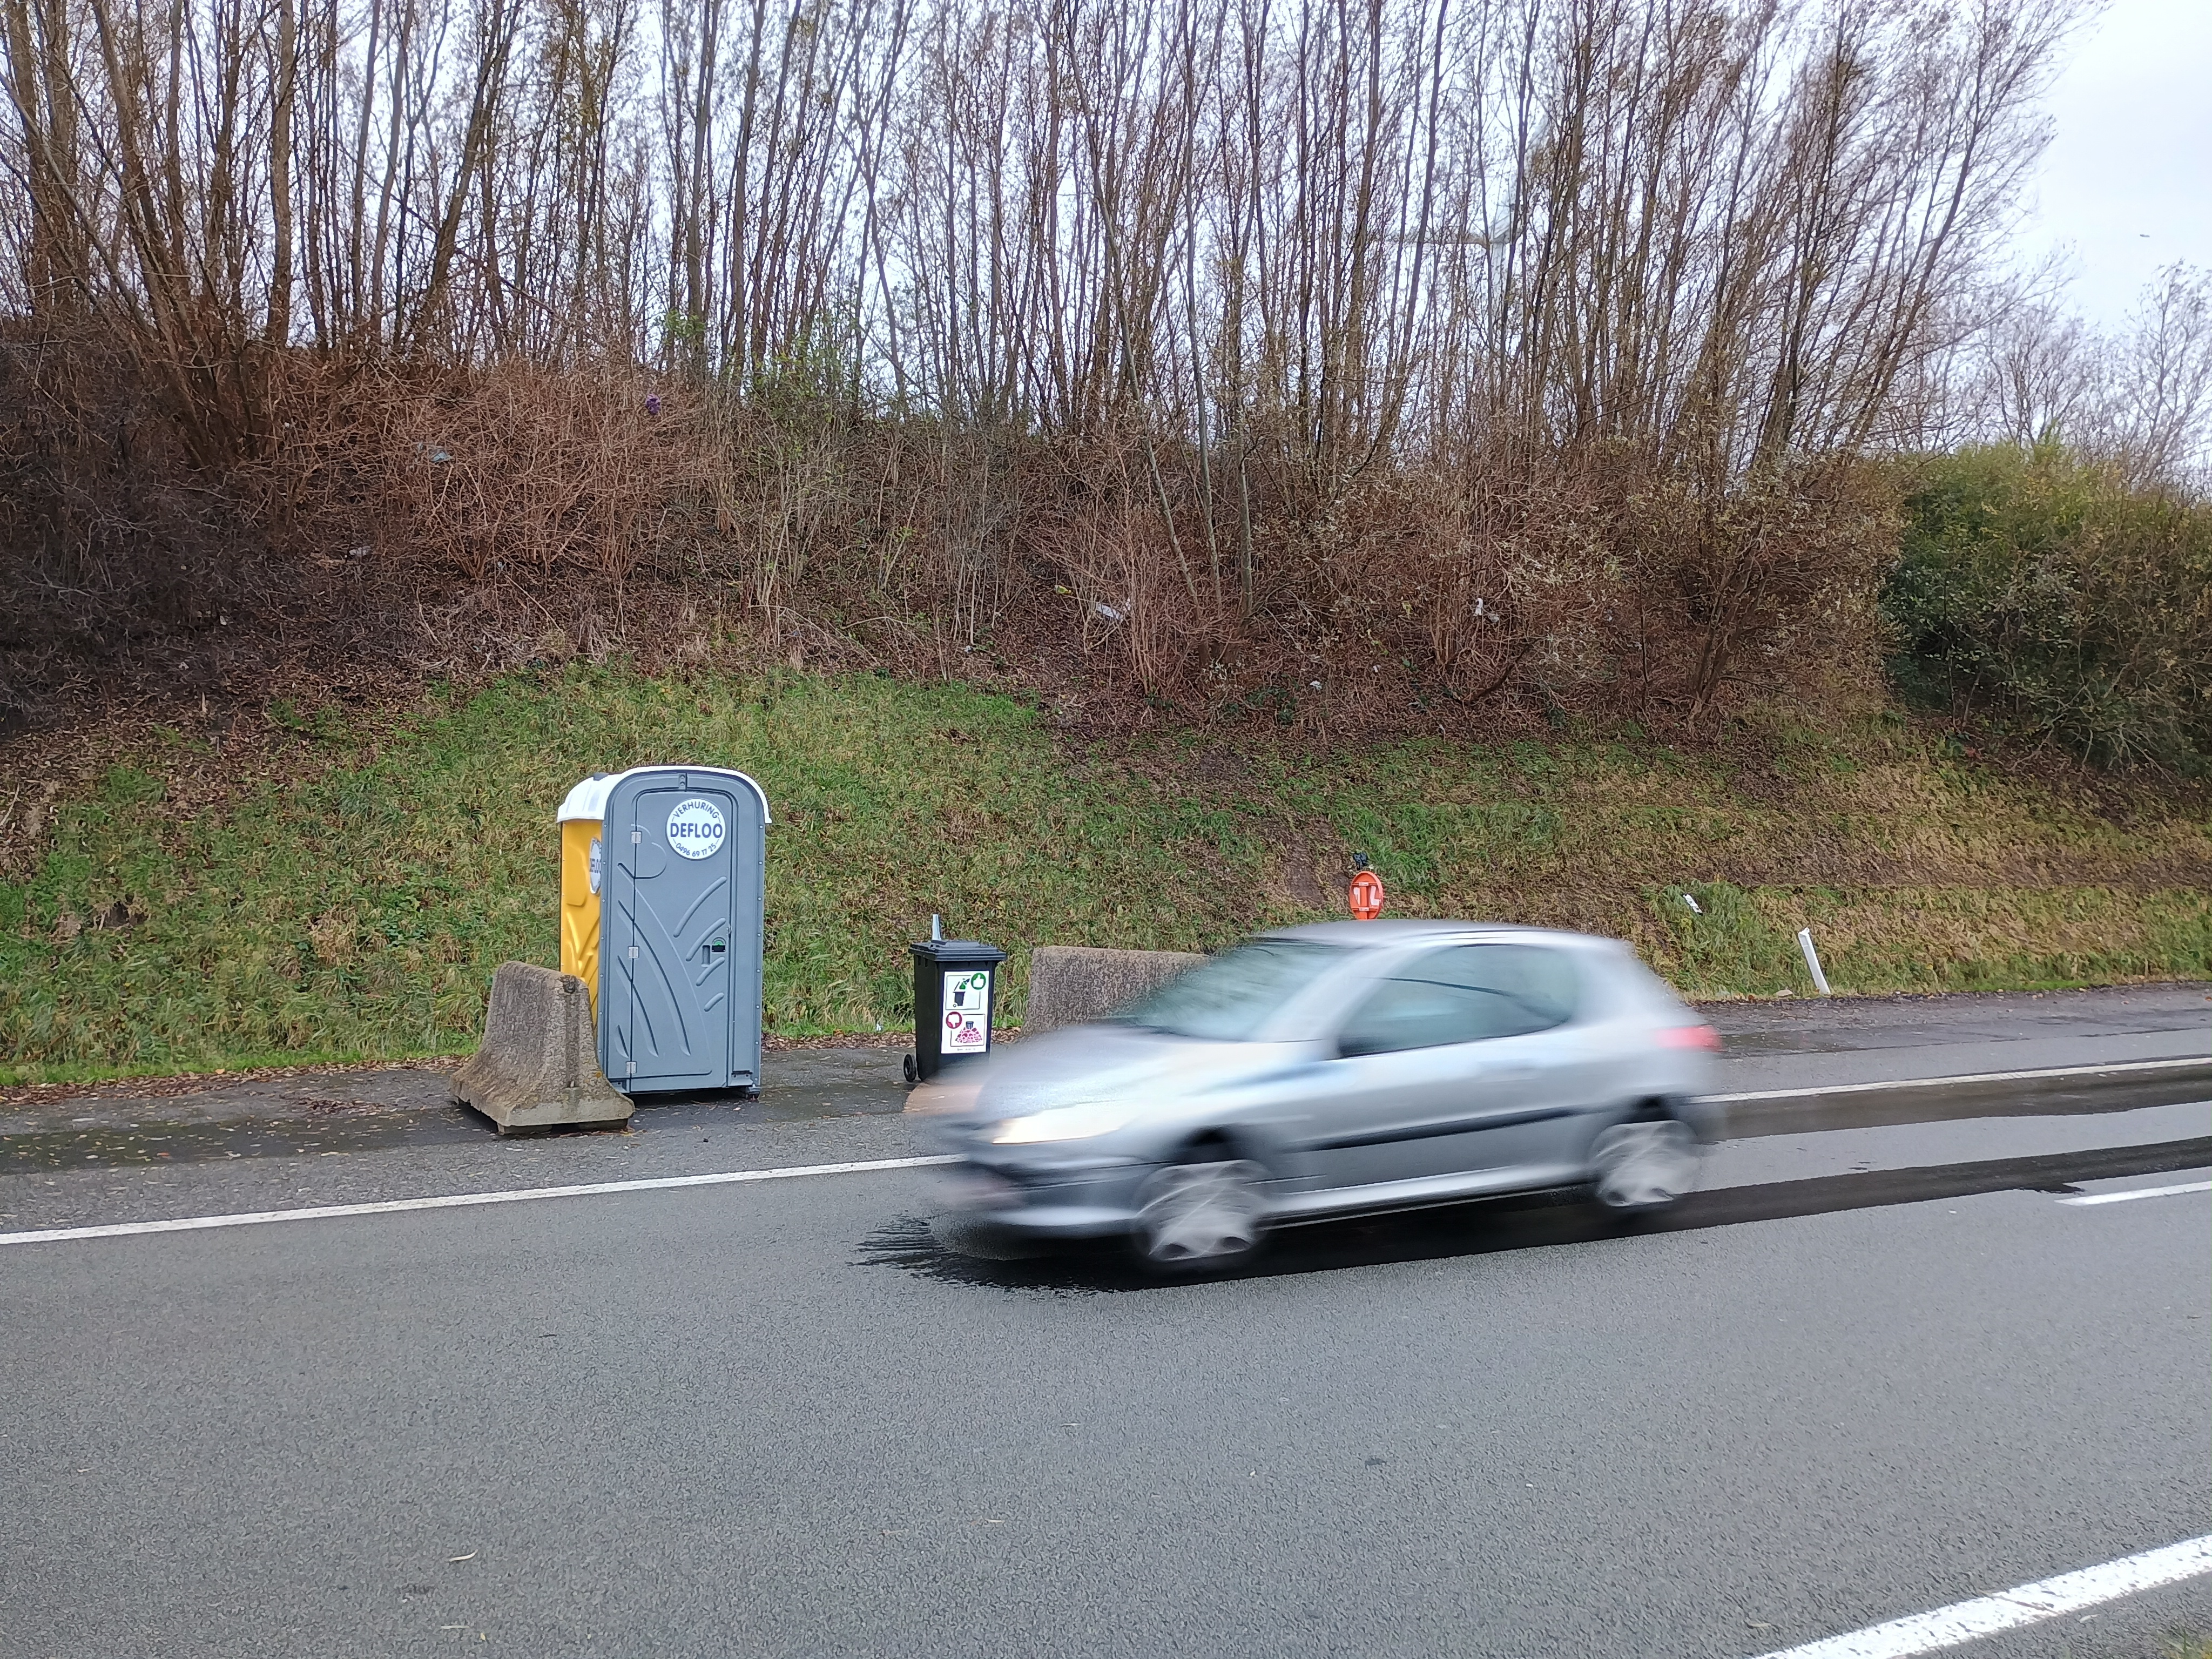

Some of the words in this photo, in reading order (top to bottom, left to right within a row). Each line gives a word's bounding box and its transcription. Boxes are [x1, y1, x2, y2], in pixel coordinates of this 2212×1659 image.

[673, 801, 719, 819] VERHURING
[670, 822, 723, 838] DEFLOO
[676, 842, 690, 855] 0496
[708, 842, 717, 852] 25
